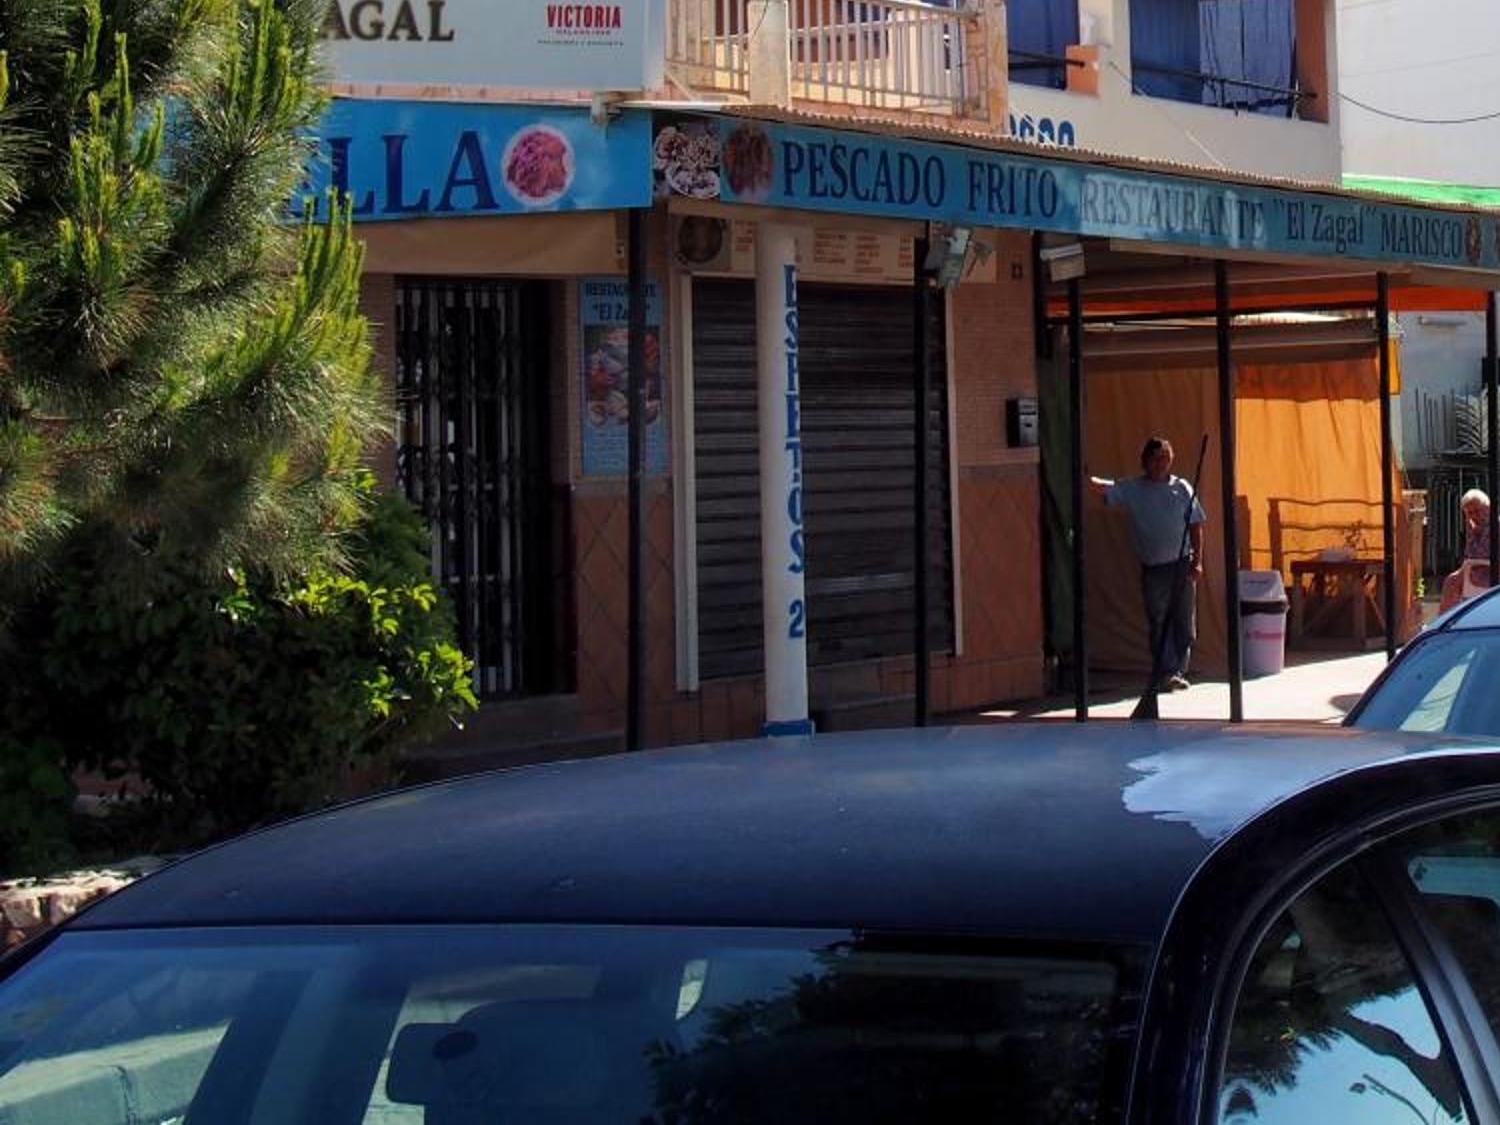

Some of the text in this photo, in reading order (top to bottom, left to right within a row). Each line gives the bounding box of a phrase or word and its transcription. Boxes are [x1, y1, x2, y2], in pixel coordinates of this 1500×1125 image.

[546, 5, 621, 27] VICTORIA
[294, 130, 500, 217] LLA
[781, 140, 945, 208] PESCADO
[967, 160, 1058, 218] FRITO
[1080, 179, 1264, 242] RESTAURANTE
[1381, 213, 1463, 259] MARISCO
[788, 598, 805, 639] 2
